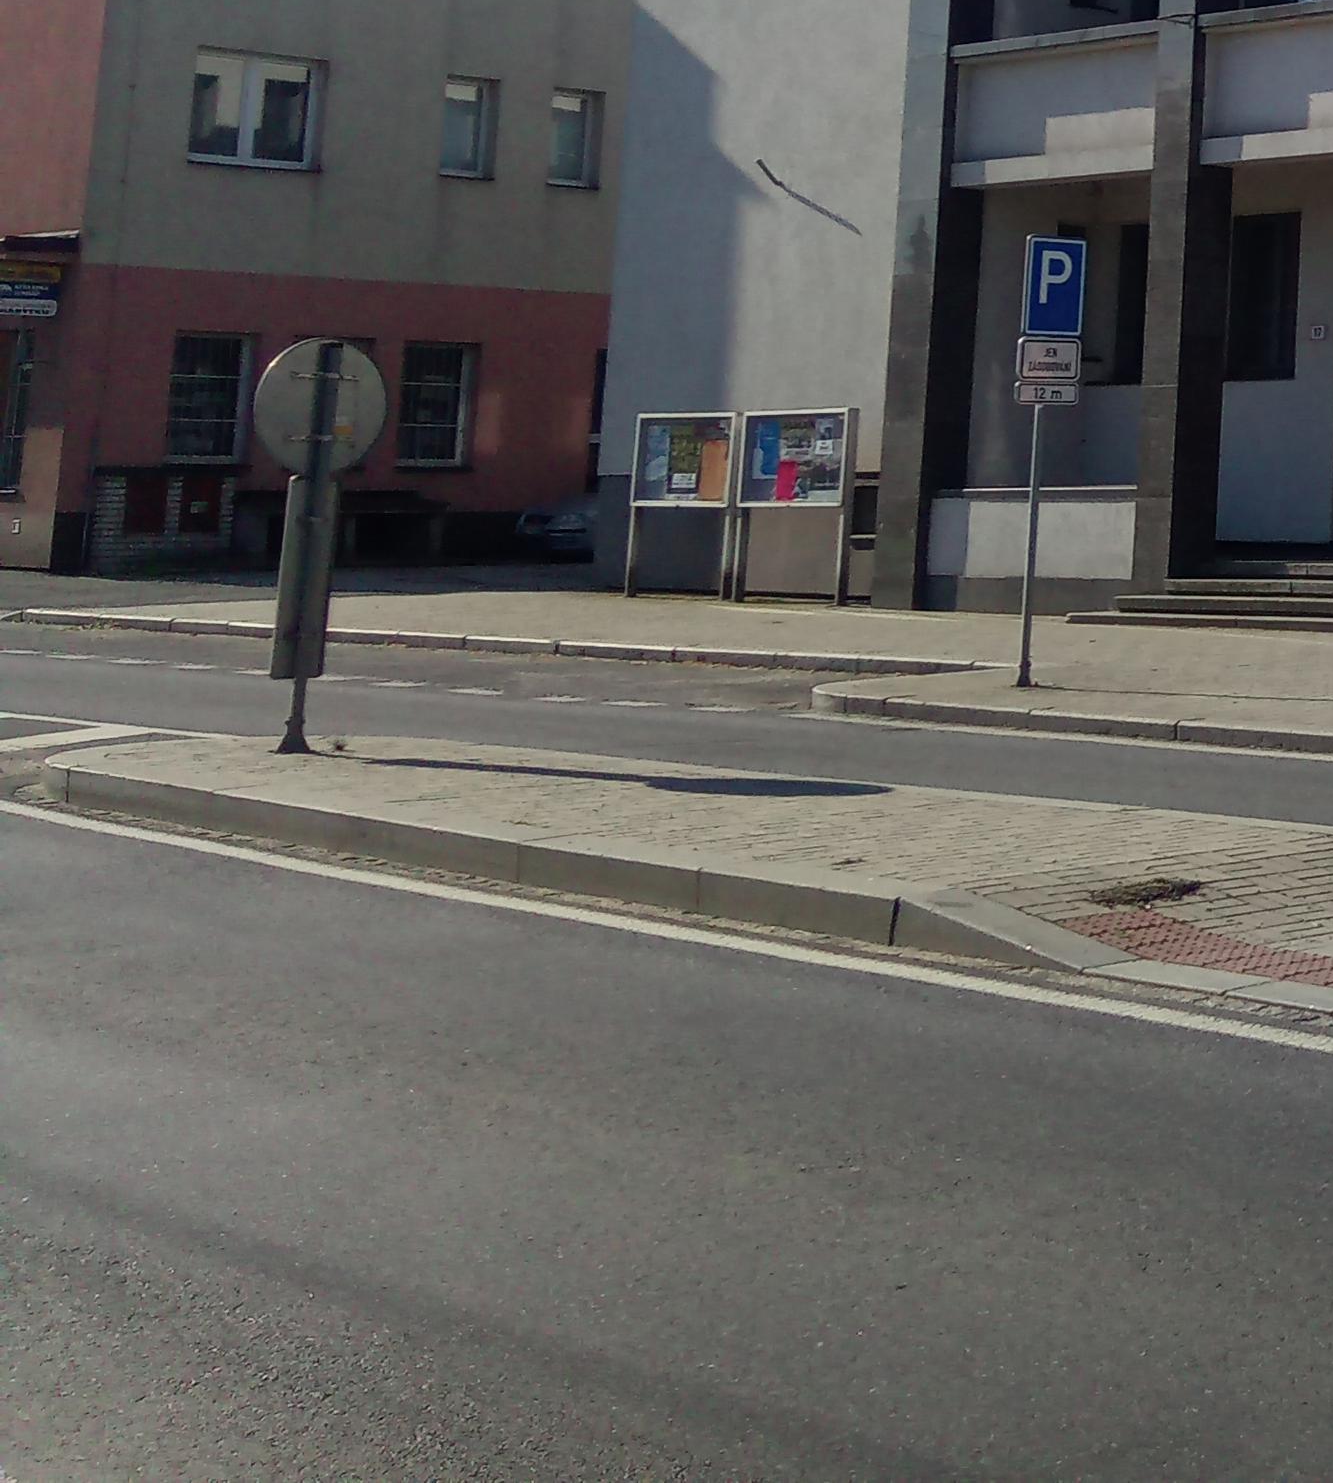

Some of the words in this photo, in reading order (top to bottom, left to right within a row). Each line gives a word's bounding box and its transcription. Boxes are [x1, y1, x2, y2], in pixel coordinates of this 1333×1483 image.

[1039, 250, 1073, 305] P
[1043, 347, 1058, 358] JEN
[1033, 387, 1046, 399] 12
[1050, 389, 1062, 399] m
